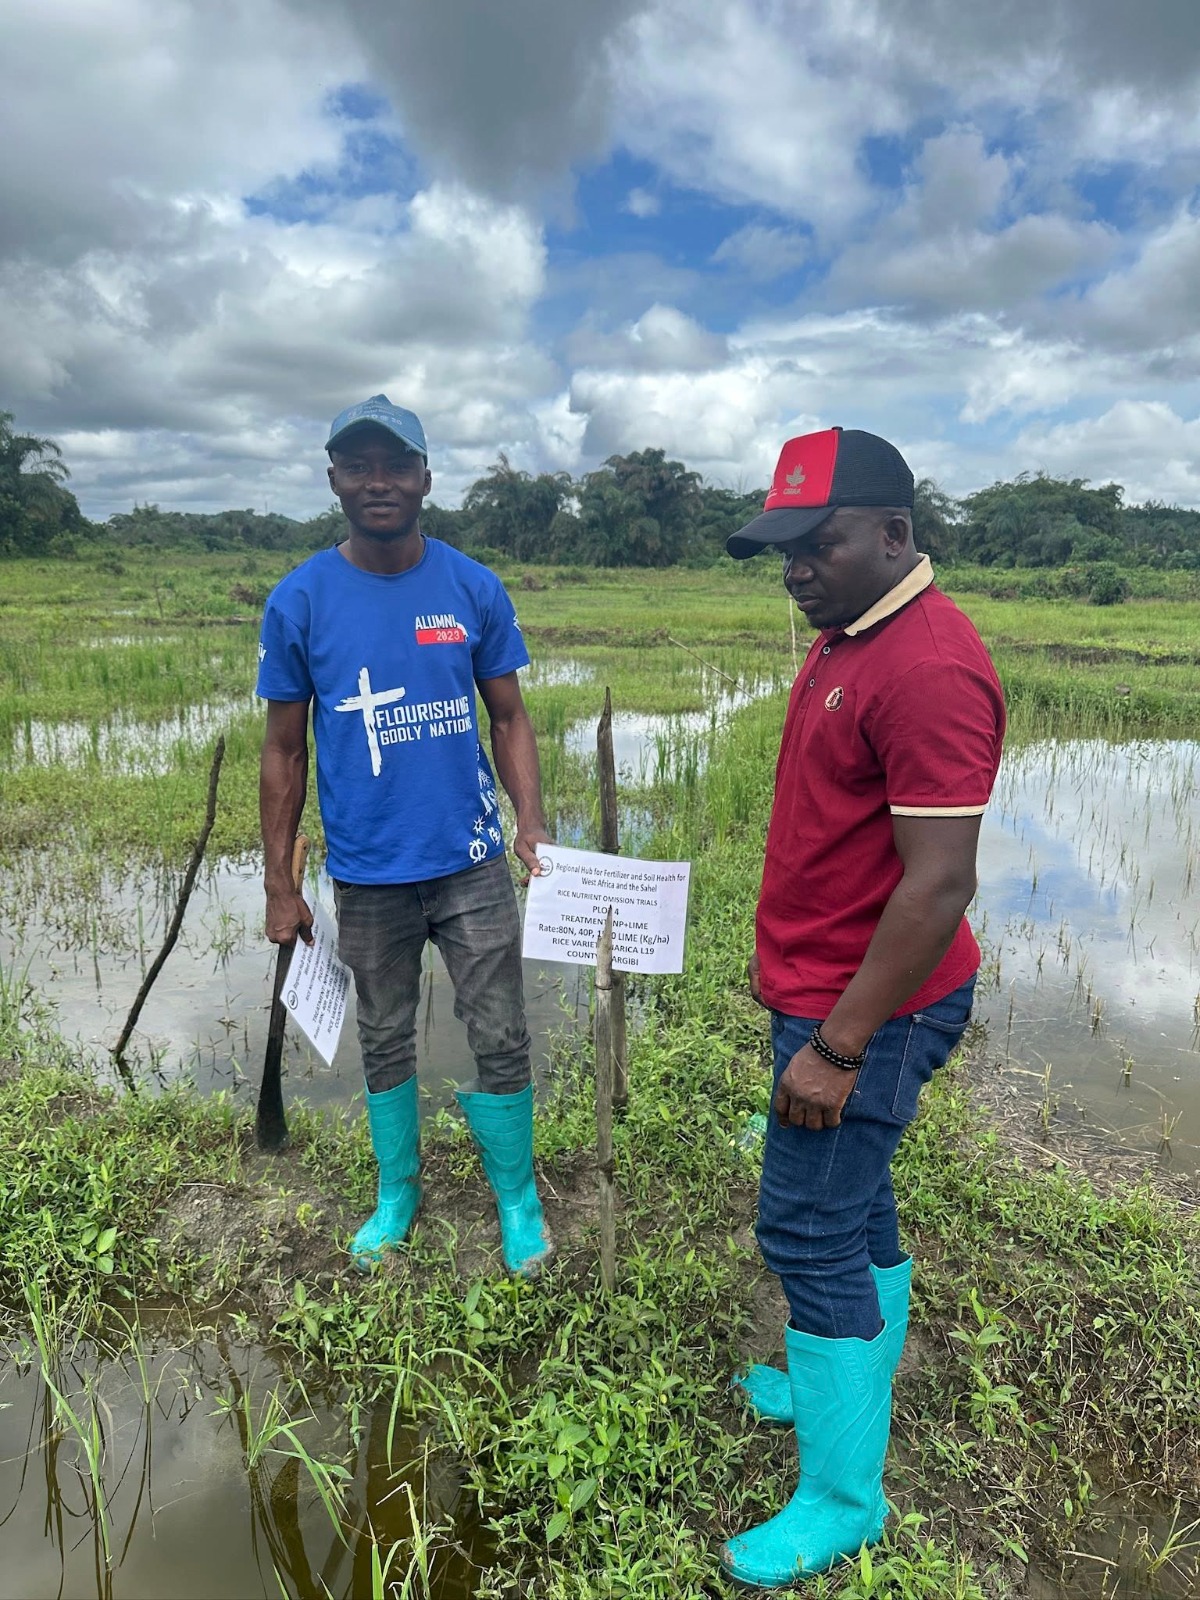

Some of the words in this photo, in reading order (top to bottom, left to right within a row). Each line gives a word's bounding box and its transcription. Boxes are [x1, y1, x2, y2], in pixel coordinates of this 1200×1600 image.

[415, 613, 457, 630] ALUMNI
[436, 630, 460, 641] 2023
[374, 695, 470, 729] FLOURISHING
[380, 725, 422, 746] GODLY
[556, 862, 580, 873] Regional
[581, 865, 593, 875] Hub
[594, 867, 602, 876] for
[604, 869, 629, 880] Fertilizer
[631, 872, 643, 881] and
[643, 873, 655, 882] Soil
[656, 874, 676, 882] Health
[677, 873, 686, 882] for
[581, 877, 597, 886] West
[598, 879, 615, 889] Africa
[616, 882, 627, 890] and
[629, 883, 639, 891] the
[640, 883, 657, 892] Sahel
[557, 889, 570, 897] RICE
[571, 891, 602, 901] NUTRIENT
[603, 895, 634, 905] OMISSION
[637, 898, 658, 907] TRIALS
[592, 905, 611, 914] PLO
[538, 923, 577, 936] Rate:80N,
[578, 928, 595, 939] 40P,
[618, 932, 638, 942] LIME
[640, 934, 670, 945] (Kg/ha)
[552, 937, 570, 946] RICE
[640, 947, 655, 955] L19
[612, 955, 639, 966] ARGIBI
